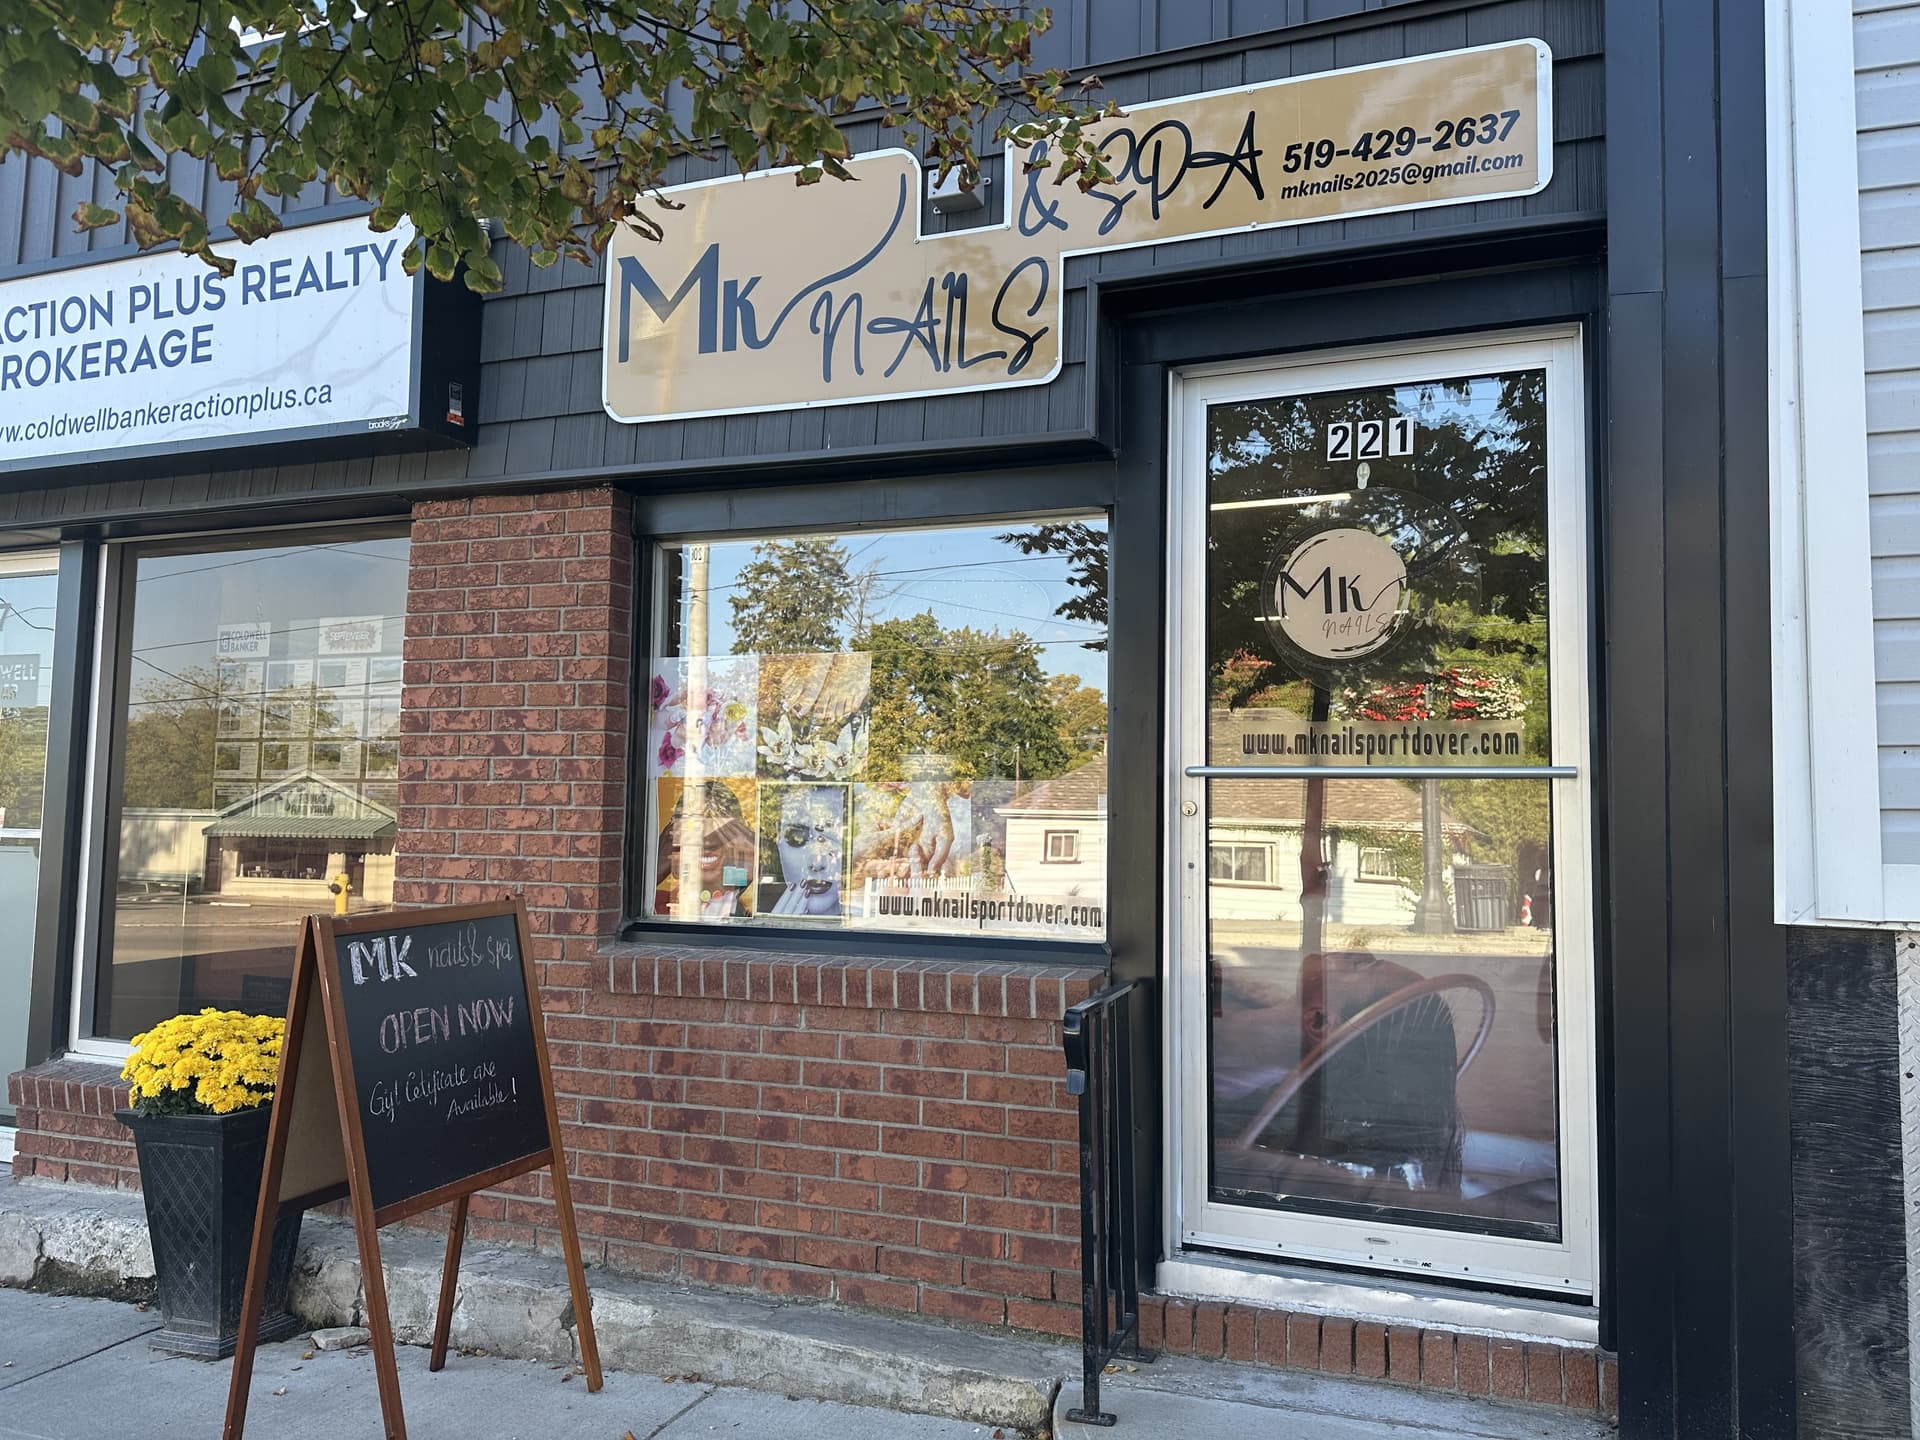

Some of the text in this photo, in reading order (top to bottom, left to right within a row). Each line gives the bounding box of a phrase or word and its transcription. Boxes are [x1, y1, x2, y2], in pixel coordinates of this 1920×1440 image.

[1282, 109, 1521, 173] 519-429-2637
[1018, 110, 1265, 238] & SPA
[1280, 154, 1523, 199] mknails2025@gmail.com
[128, 271, 227, 324] PLUS
[242, 239, 398, 306] REALTY
[810, 256, 1050, 383] NAILS
[1328, 419, 1411, 460] 221
[1279, 566, 1407, 619] MK
[231, 629, 268, 642] COLDWELL
[231, 640, 260, 653] BANKER
[1322, 612, 1388, 640] NAILS
[1242, 725, 1520, 765] www.mknailsportdover.com
[879, 891, 1102, 930] www.mknailsportdover.com
[347, 935, 418, 985] MK
[379, 995, 514, 1054] OPEN NOW
[369, 1079, 400, 1123] Gift
